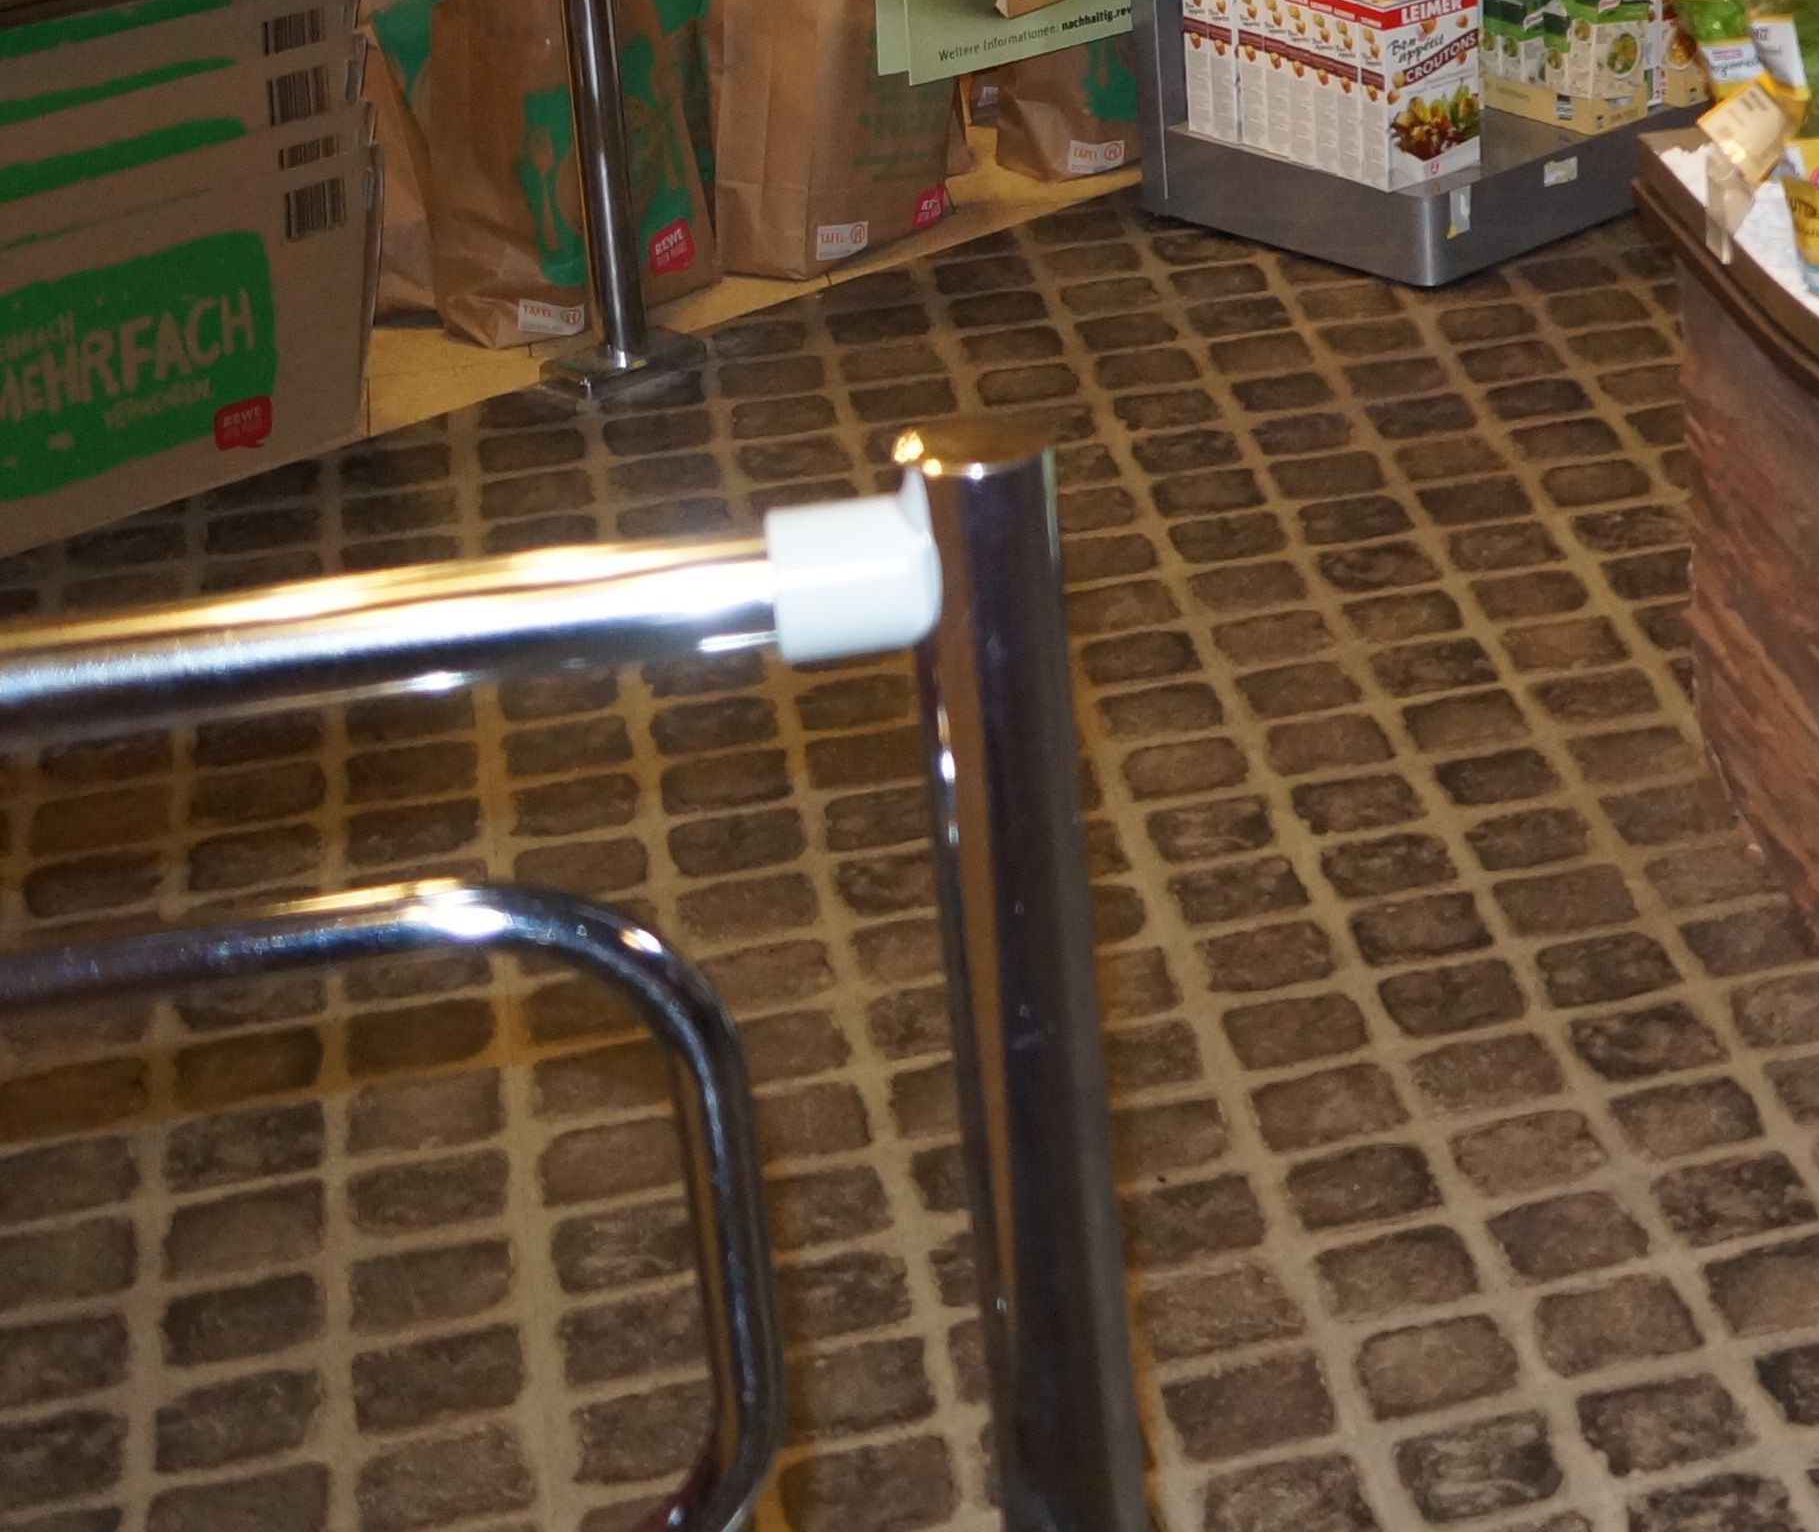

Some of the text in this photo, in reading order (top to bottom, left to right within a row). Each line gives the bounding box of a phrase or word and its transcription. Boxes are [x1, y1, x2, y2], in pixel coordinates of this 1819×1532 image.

[938, 42, 980, 62] Weitere
[983, 25, 1059, 52] Informationen:
[1387, 37, 1417, 56] Bon
[1404, 36, 1477, 84] CROUTONS
[653, 226, 685, 257] REWE
[819, 231, 844, 245] TAFEL
[522, 304, 552, 319] TAFEL
